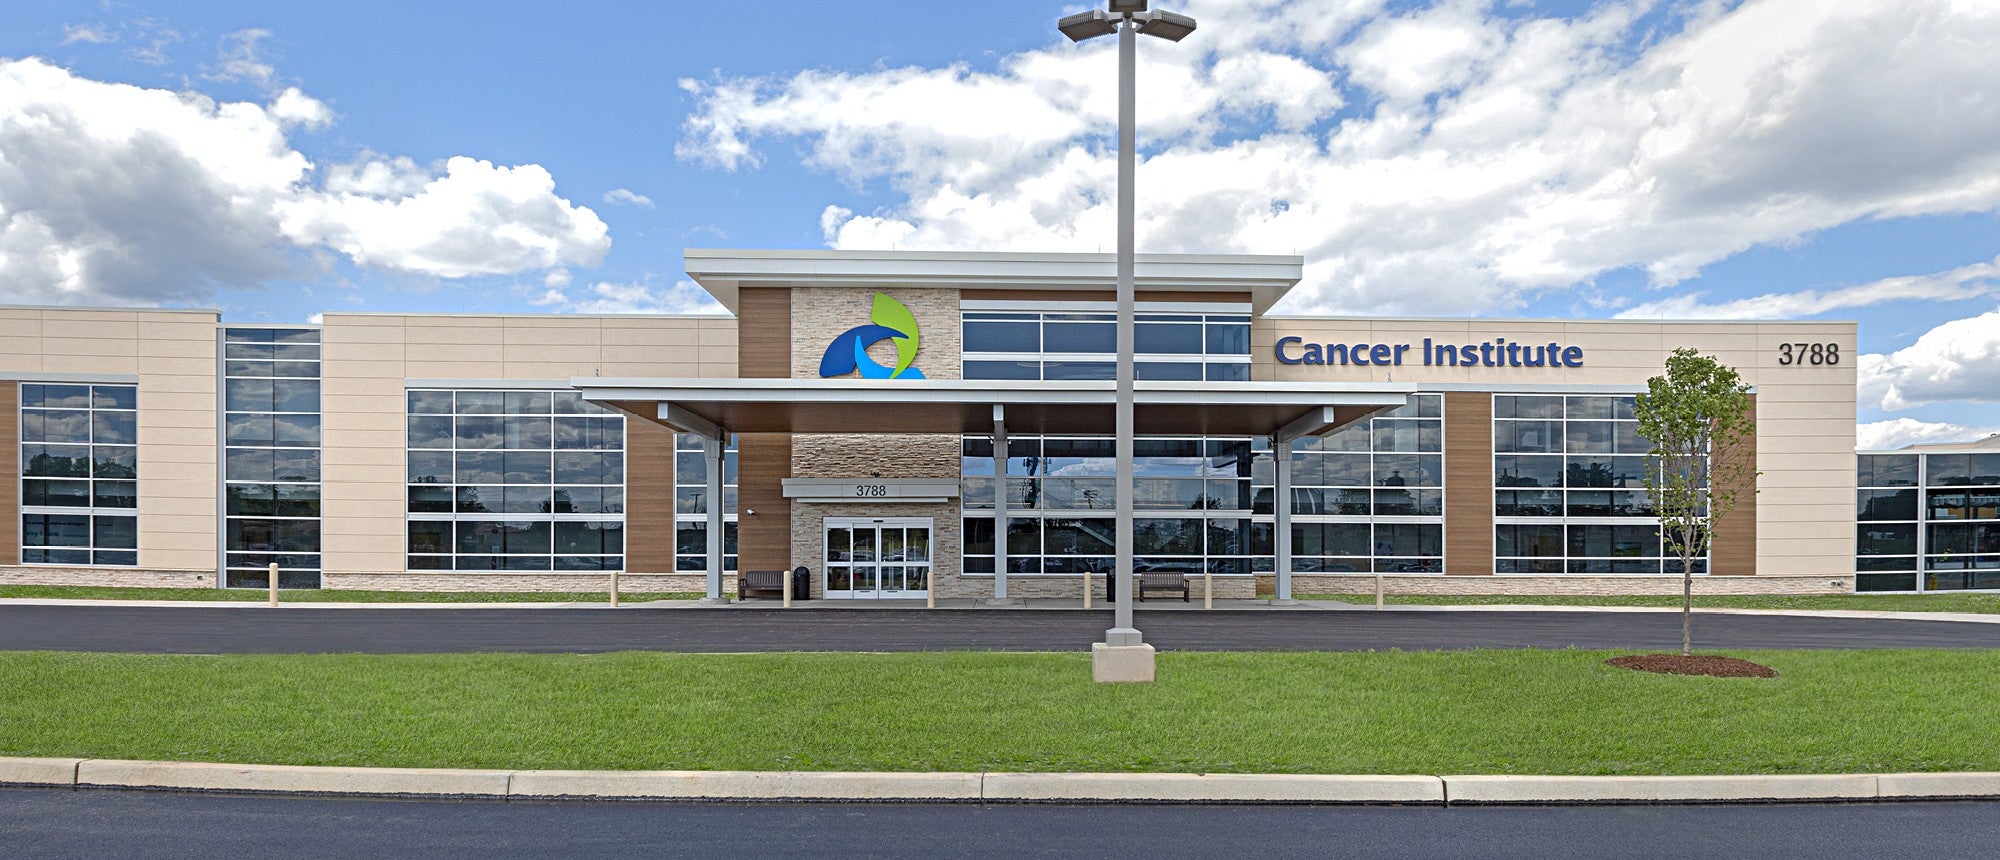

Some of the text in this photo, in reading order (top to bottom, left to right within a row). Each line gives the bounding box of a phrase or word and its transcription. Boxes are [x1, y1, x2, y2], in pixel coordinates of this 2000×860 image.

[1275, 336, 1583, 367] Cancer Institute
[1779, 343, 1839, 365] 3788
[857, 485, 886, 496] 3788
